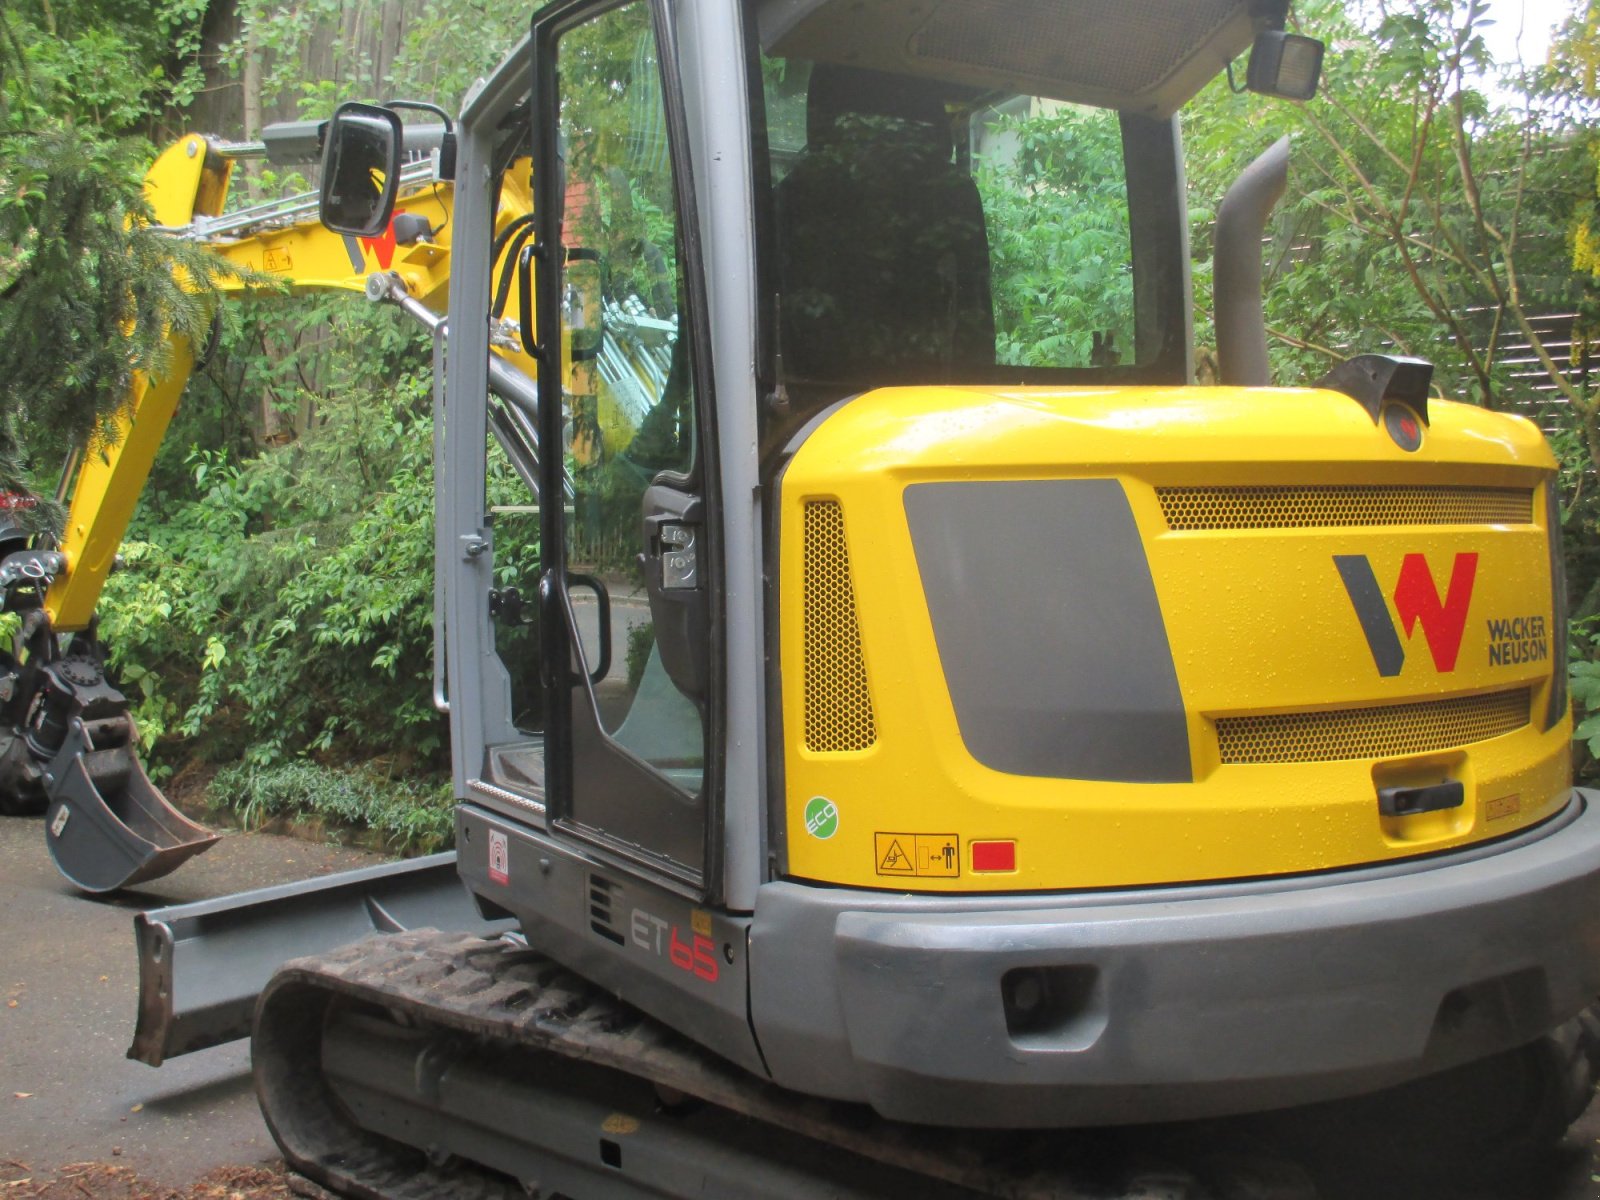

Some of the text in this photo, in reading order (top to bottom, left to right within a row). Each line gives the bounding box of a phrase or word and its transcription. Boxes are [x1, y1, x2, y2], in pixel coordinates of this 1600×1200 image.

[1486, 615, 1546, 642] WACKER
[1488, 639, 1548, 667] NEUSON
[807, 803, 836, 834] ECO
